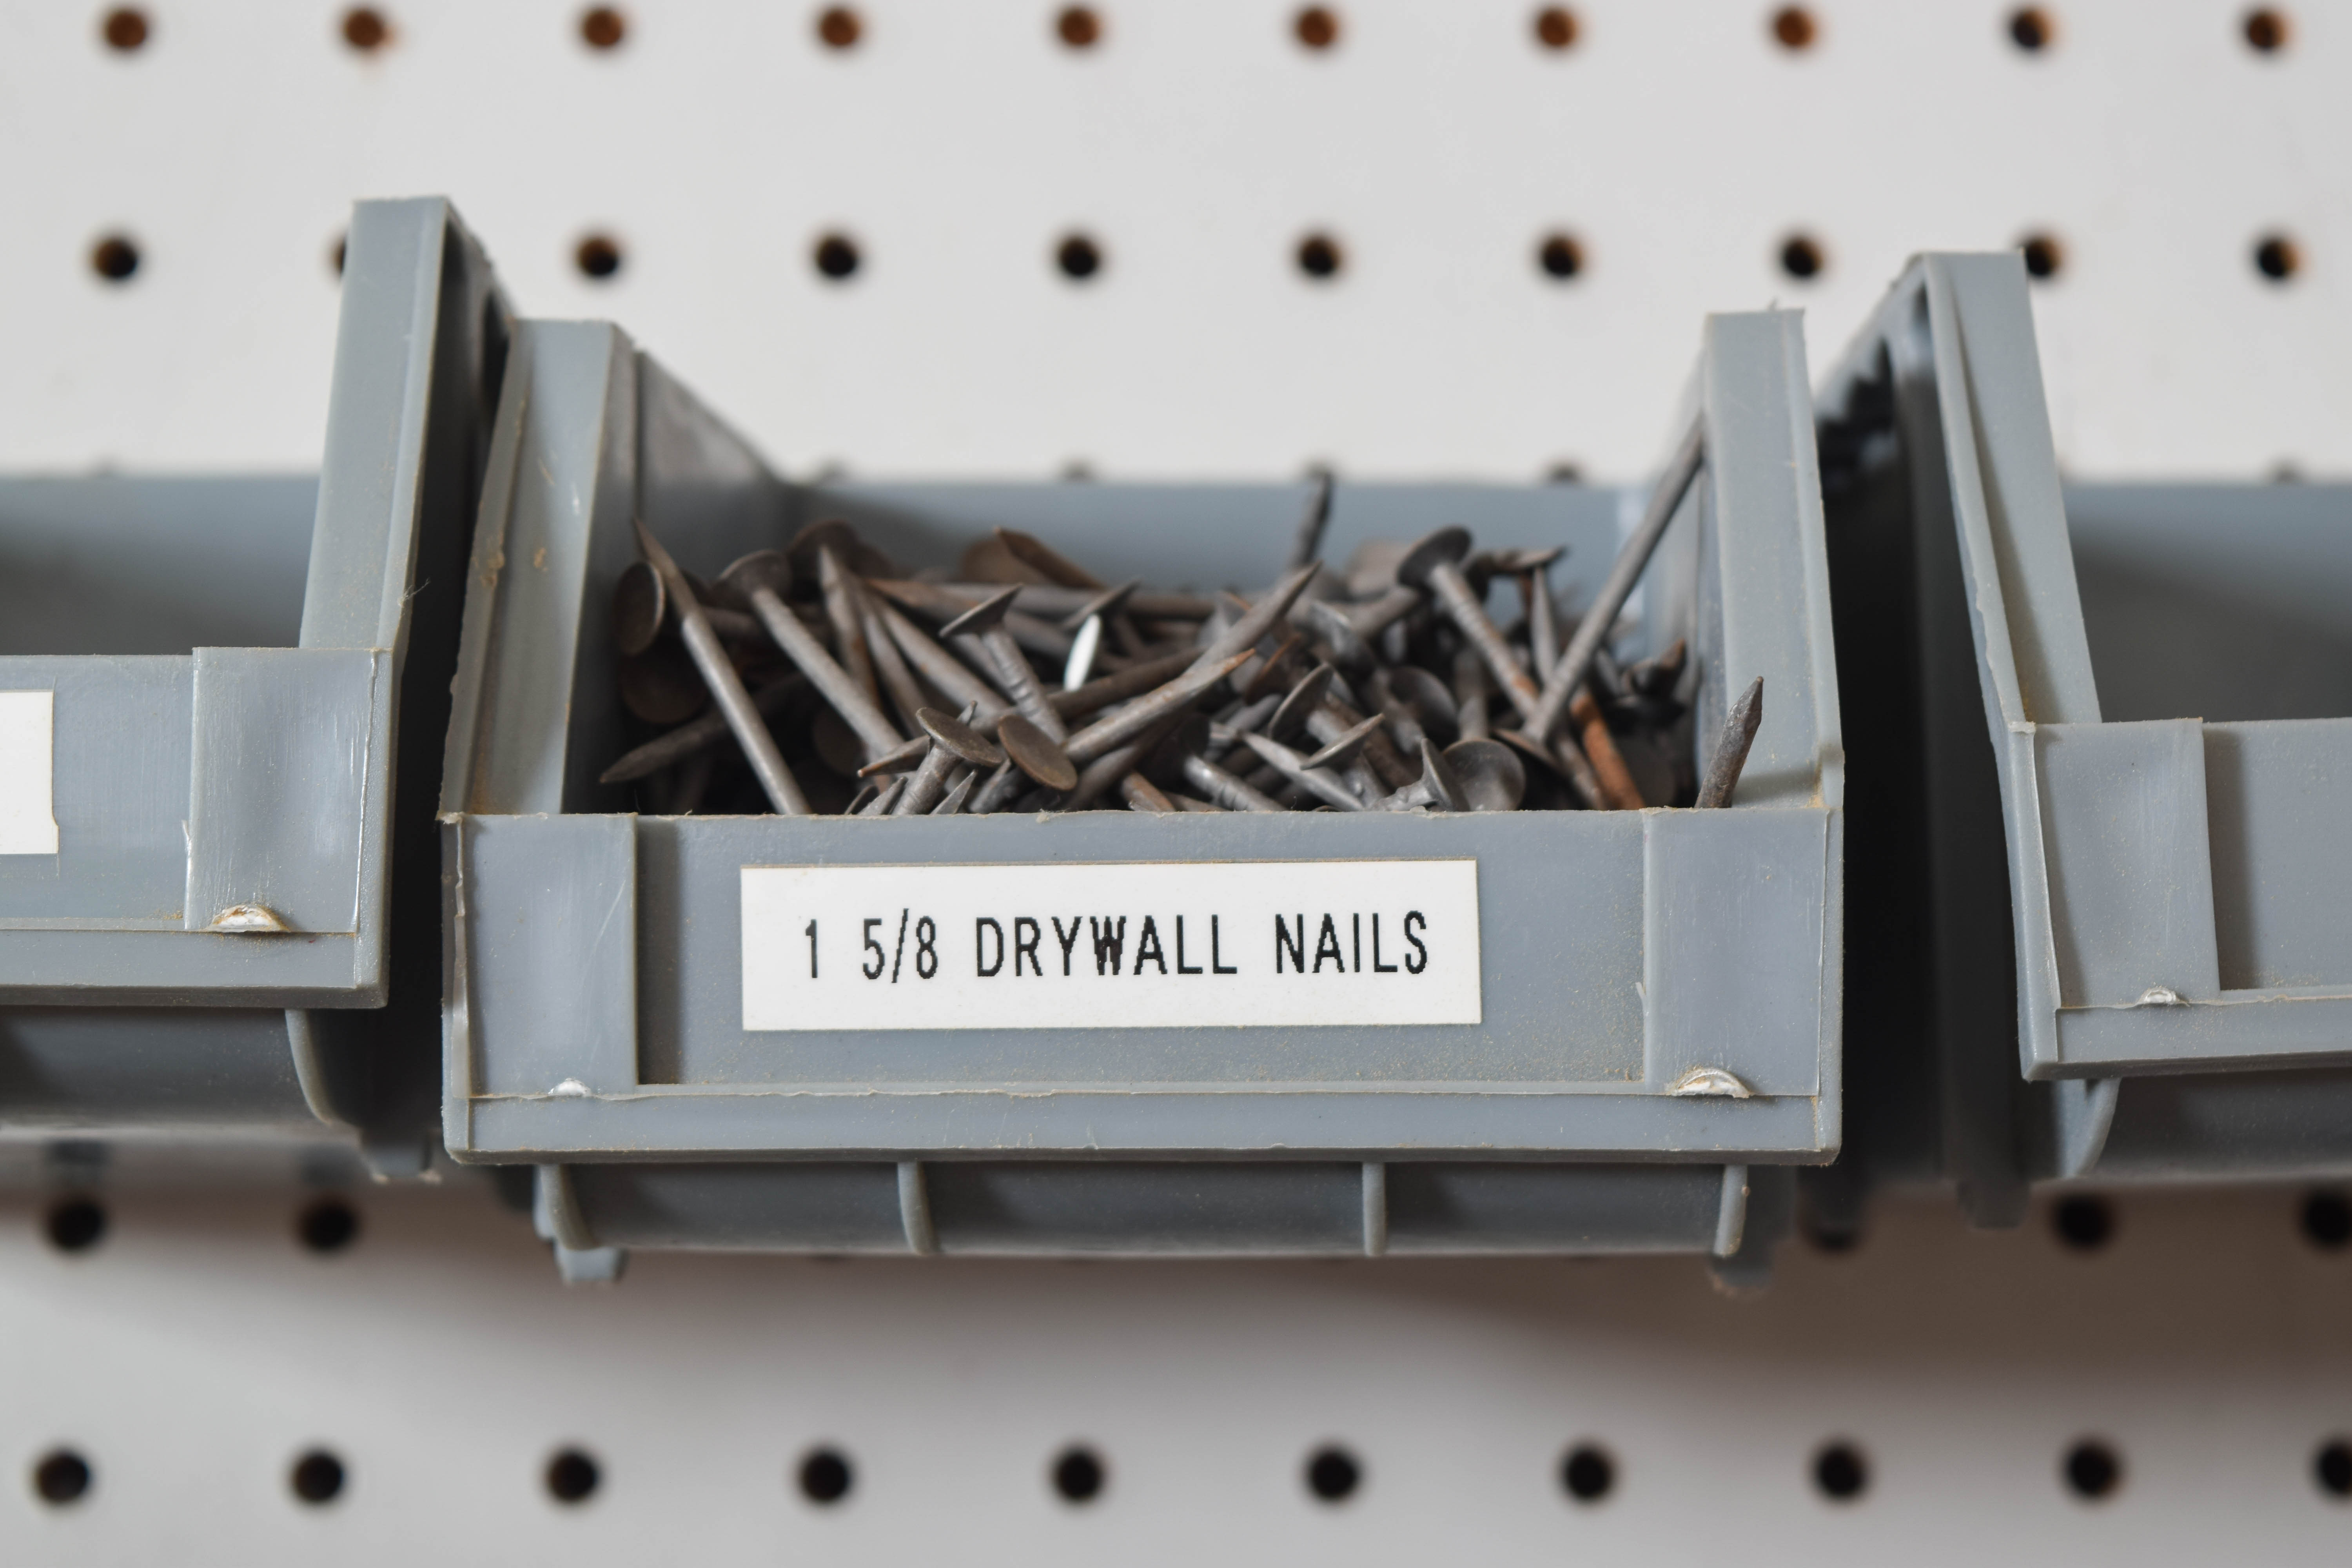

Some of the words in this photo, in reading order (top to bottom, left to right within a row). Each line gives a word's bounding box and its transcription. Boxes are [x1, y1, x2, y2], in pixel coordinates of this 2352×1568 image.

[805, 920, 817, 979] 1
[863, 909, 938, 984] 5/8
[976, 915, 1238, 977] DRYWALL
[1275, 911, 1428, 974] NAILS
